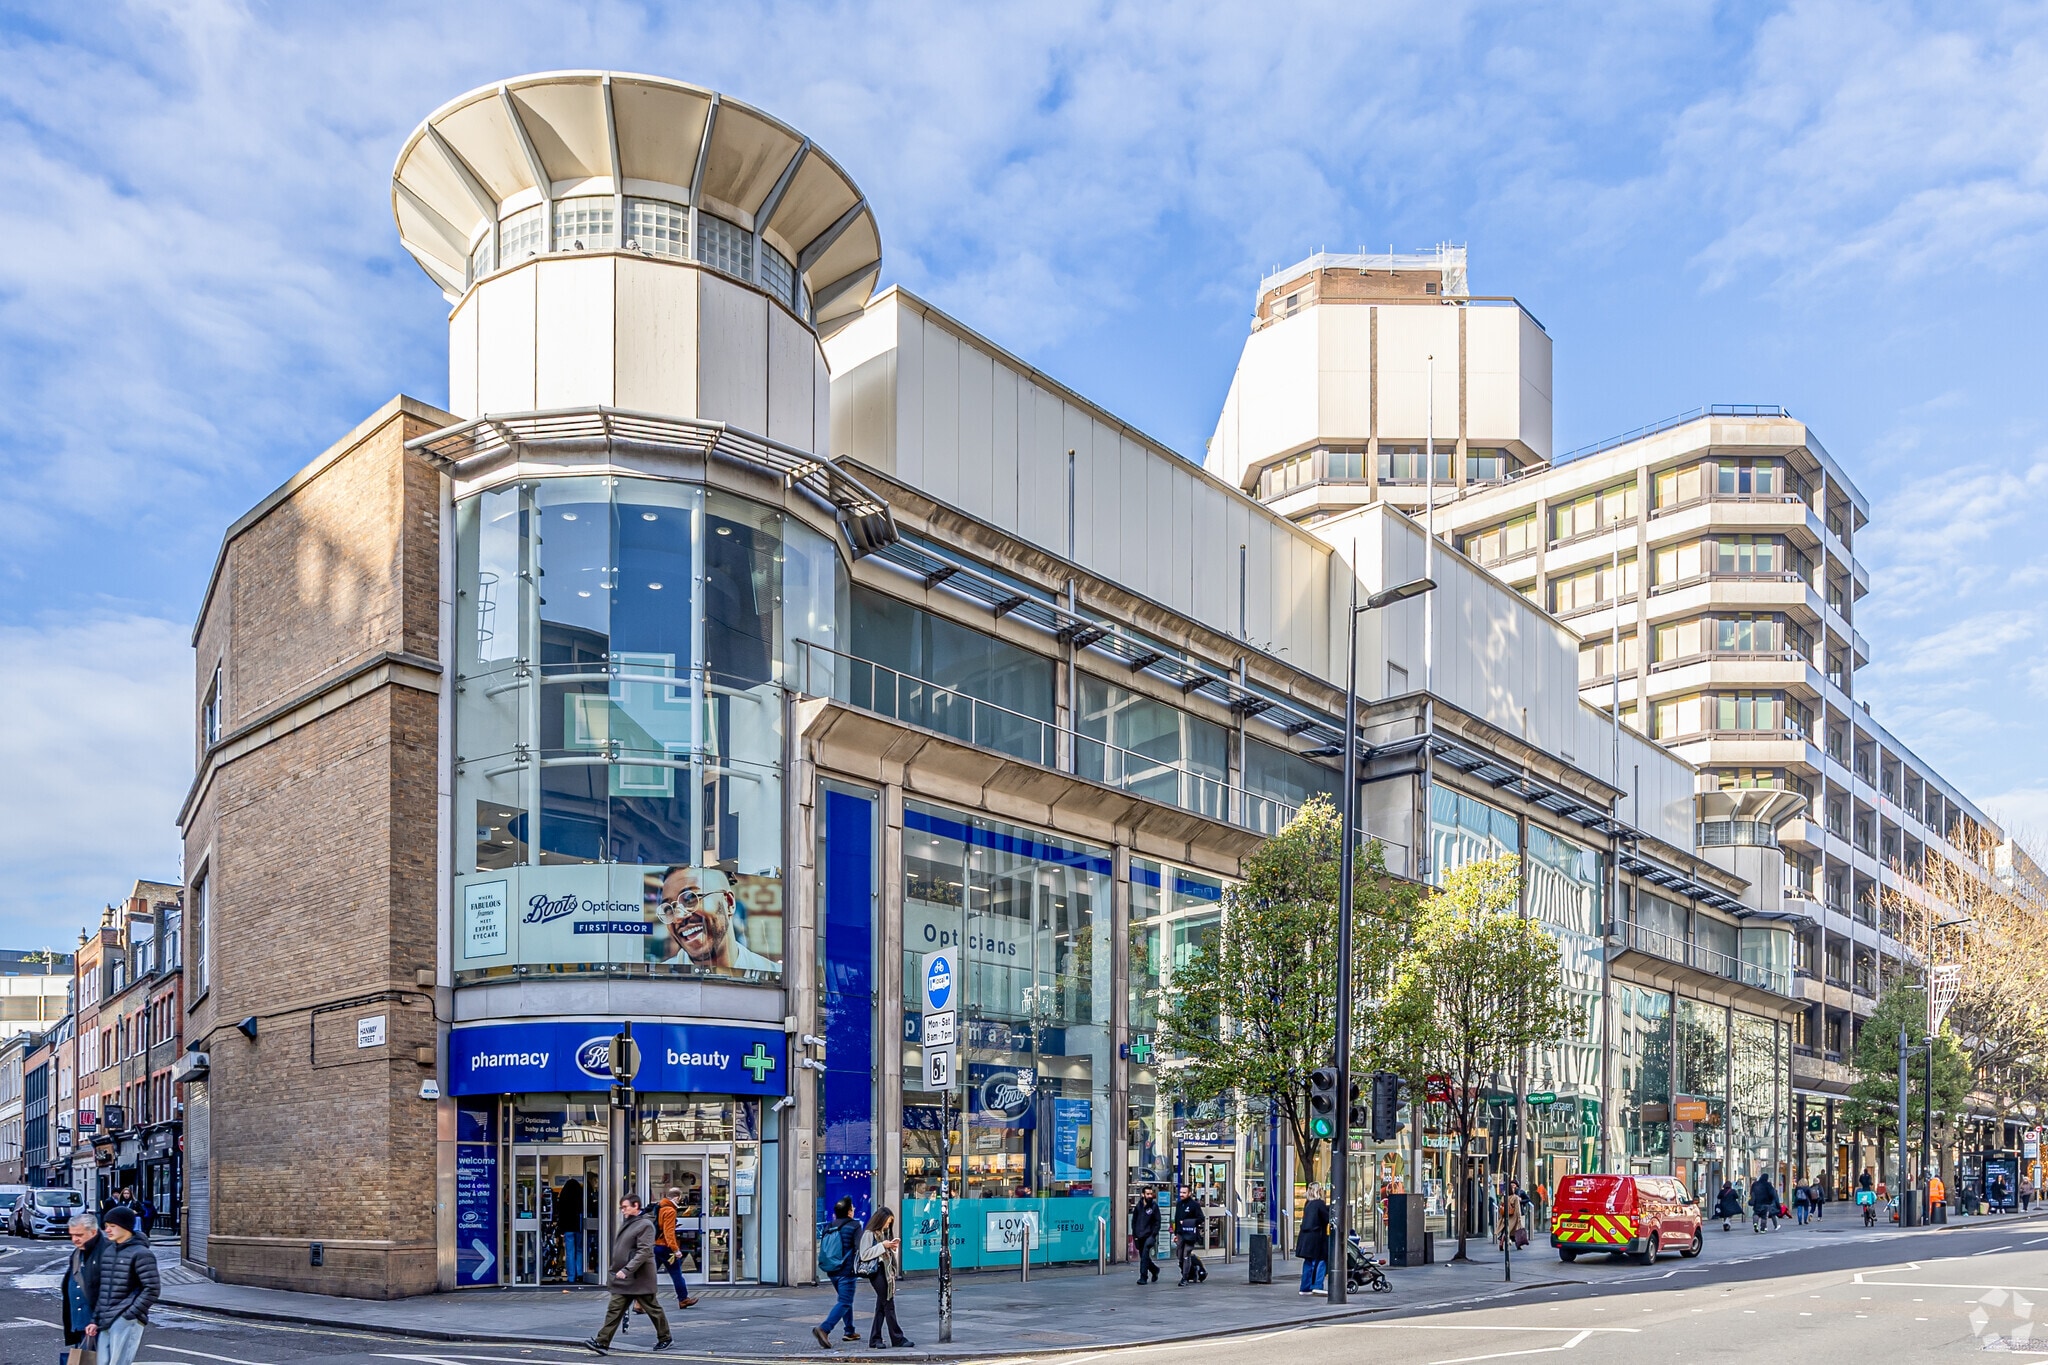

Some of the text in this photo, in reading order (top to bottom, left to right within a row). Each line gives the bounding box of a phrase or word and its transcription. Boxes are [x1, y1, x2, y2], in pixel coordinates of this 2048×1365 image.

[470, 900, 501, 910] FABULOUS
[523, 893, 640, 924] Boots Opticians
[476, 910, 494, 919] frames
[475, 924, 496, 933] EXPERT
[580, 924, 648, 932] FIRST FLOOR
[472, 931, 498, 940] EYECARE
[923, 923, 1016, 956] Optcians
[927, 1020, 938, 1029] Mon
[941, 1017, 951, 1027] Sat
[360, 1025, 377, 1035] HANWAY
[360, 1034, 375, 1044] STREET
[471, 1051, 550, 1072] pharmacy
[667, 1048, 730, 1070] beauty
[458, 1156, 496, 1165] welcome
[1057, 1223, 1084, 1232] SEE YOU
[915, 1239, 937, 1247] FIRST
